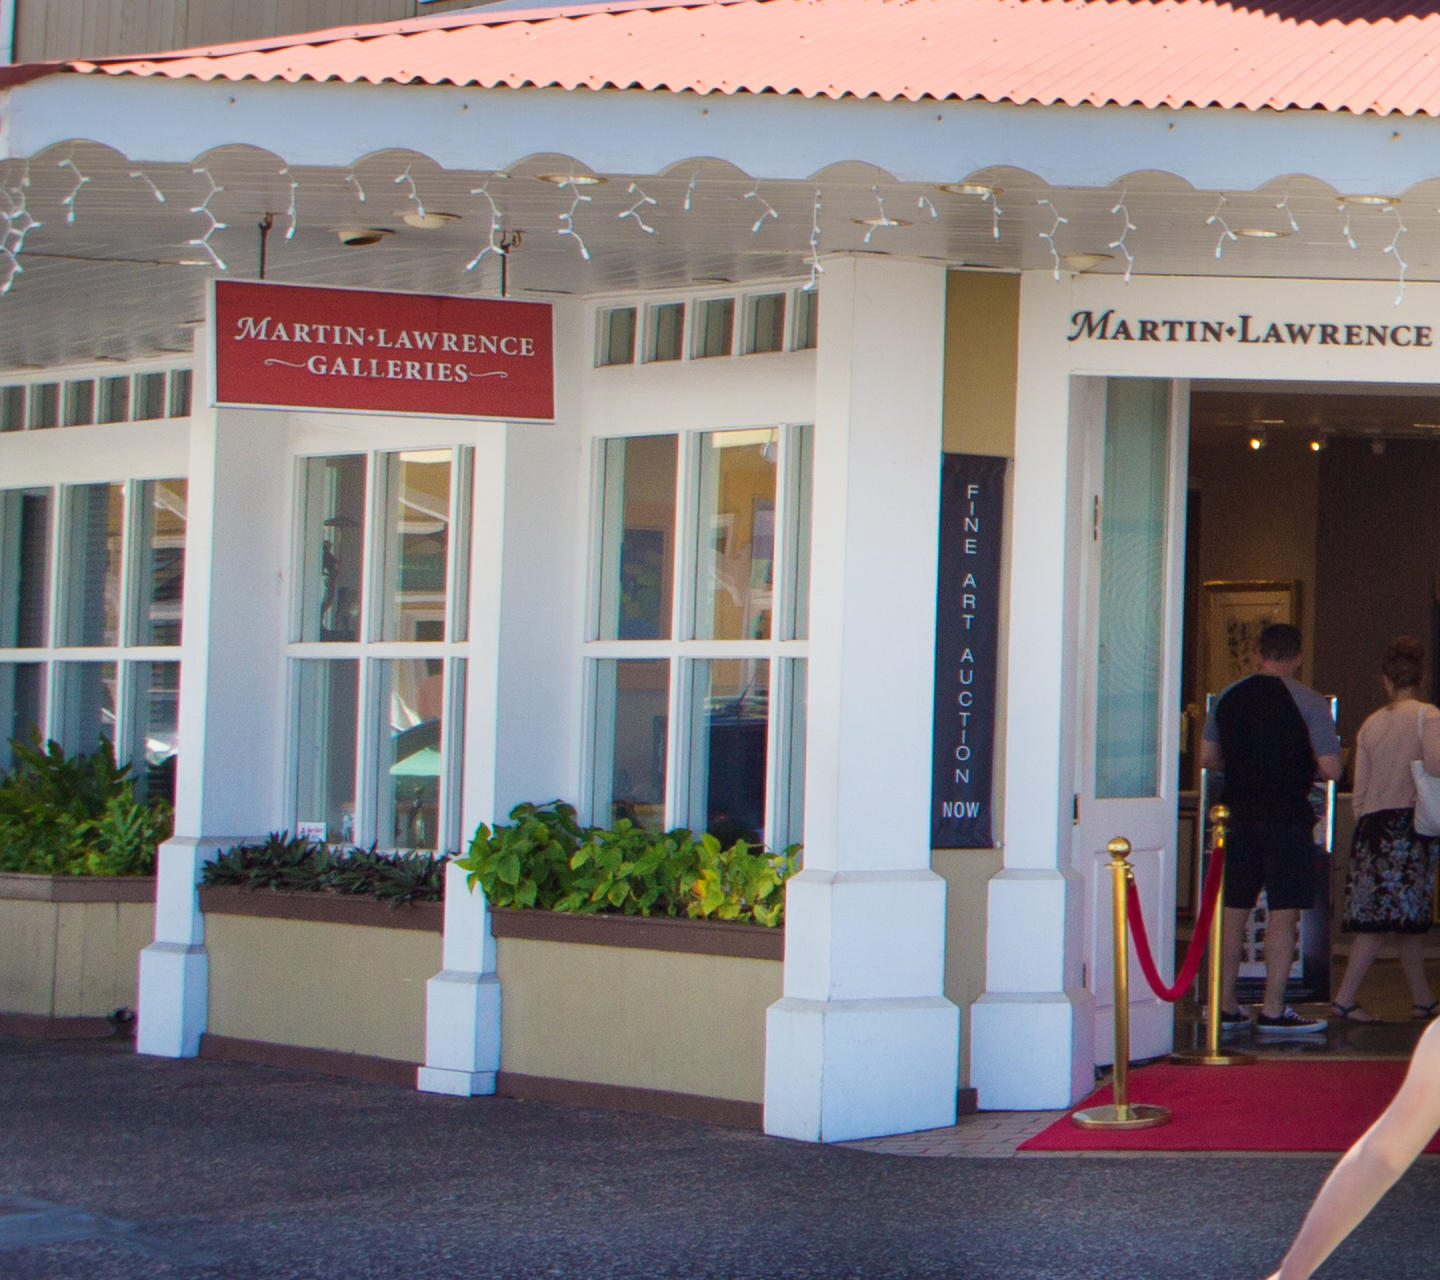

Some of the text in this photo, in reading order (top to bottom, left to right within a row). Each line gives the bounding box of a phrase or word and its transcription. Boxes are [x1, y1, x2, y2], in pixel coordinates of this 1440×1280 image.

[306, 354, 469, 383] GALLERIES
[954, 484, 980, 784] FINE ART AUCTION
[942, 801, 981, 818] NOW
